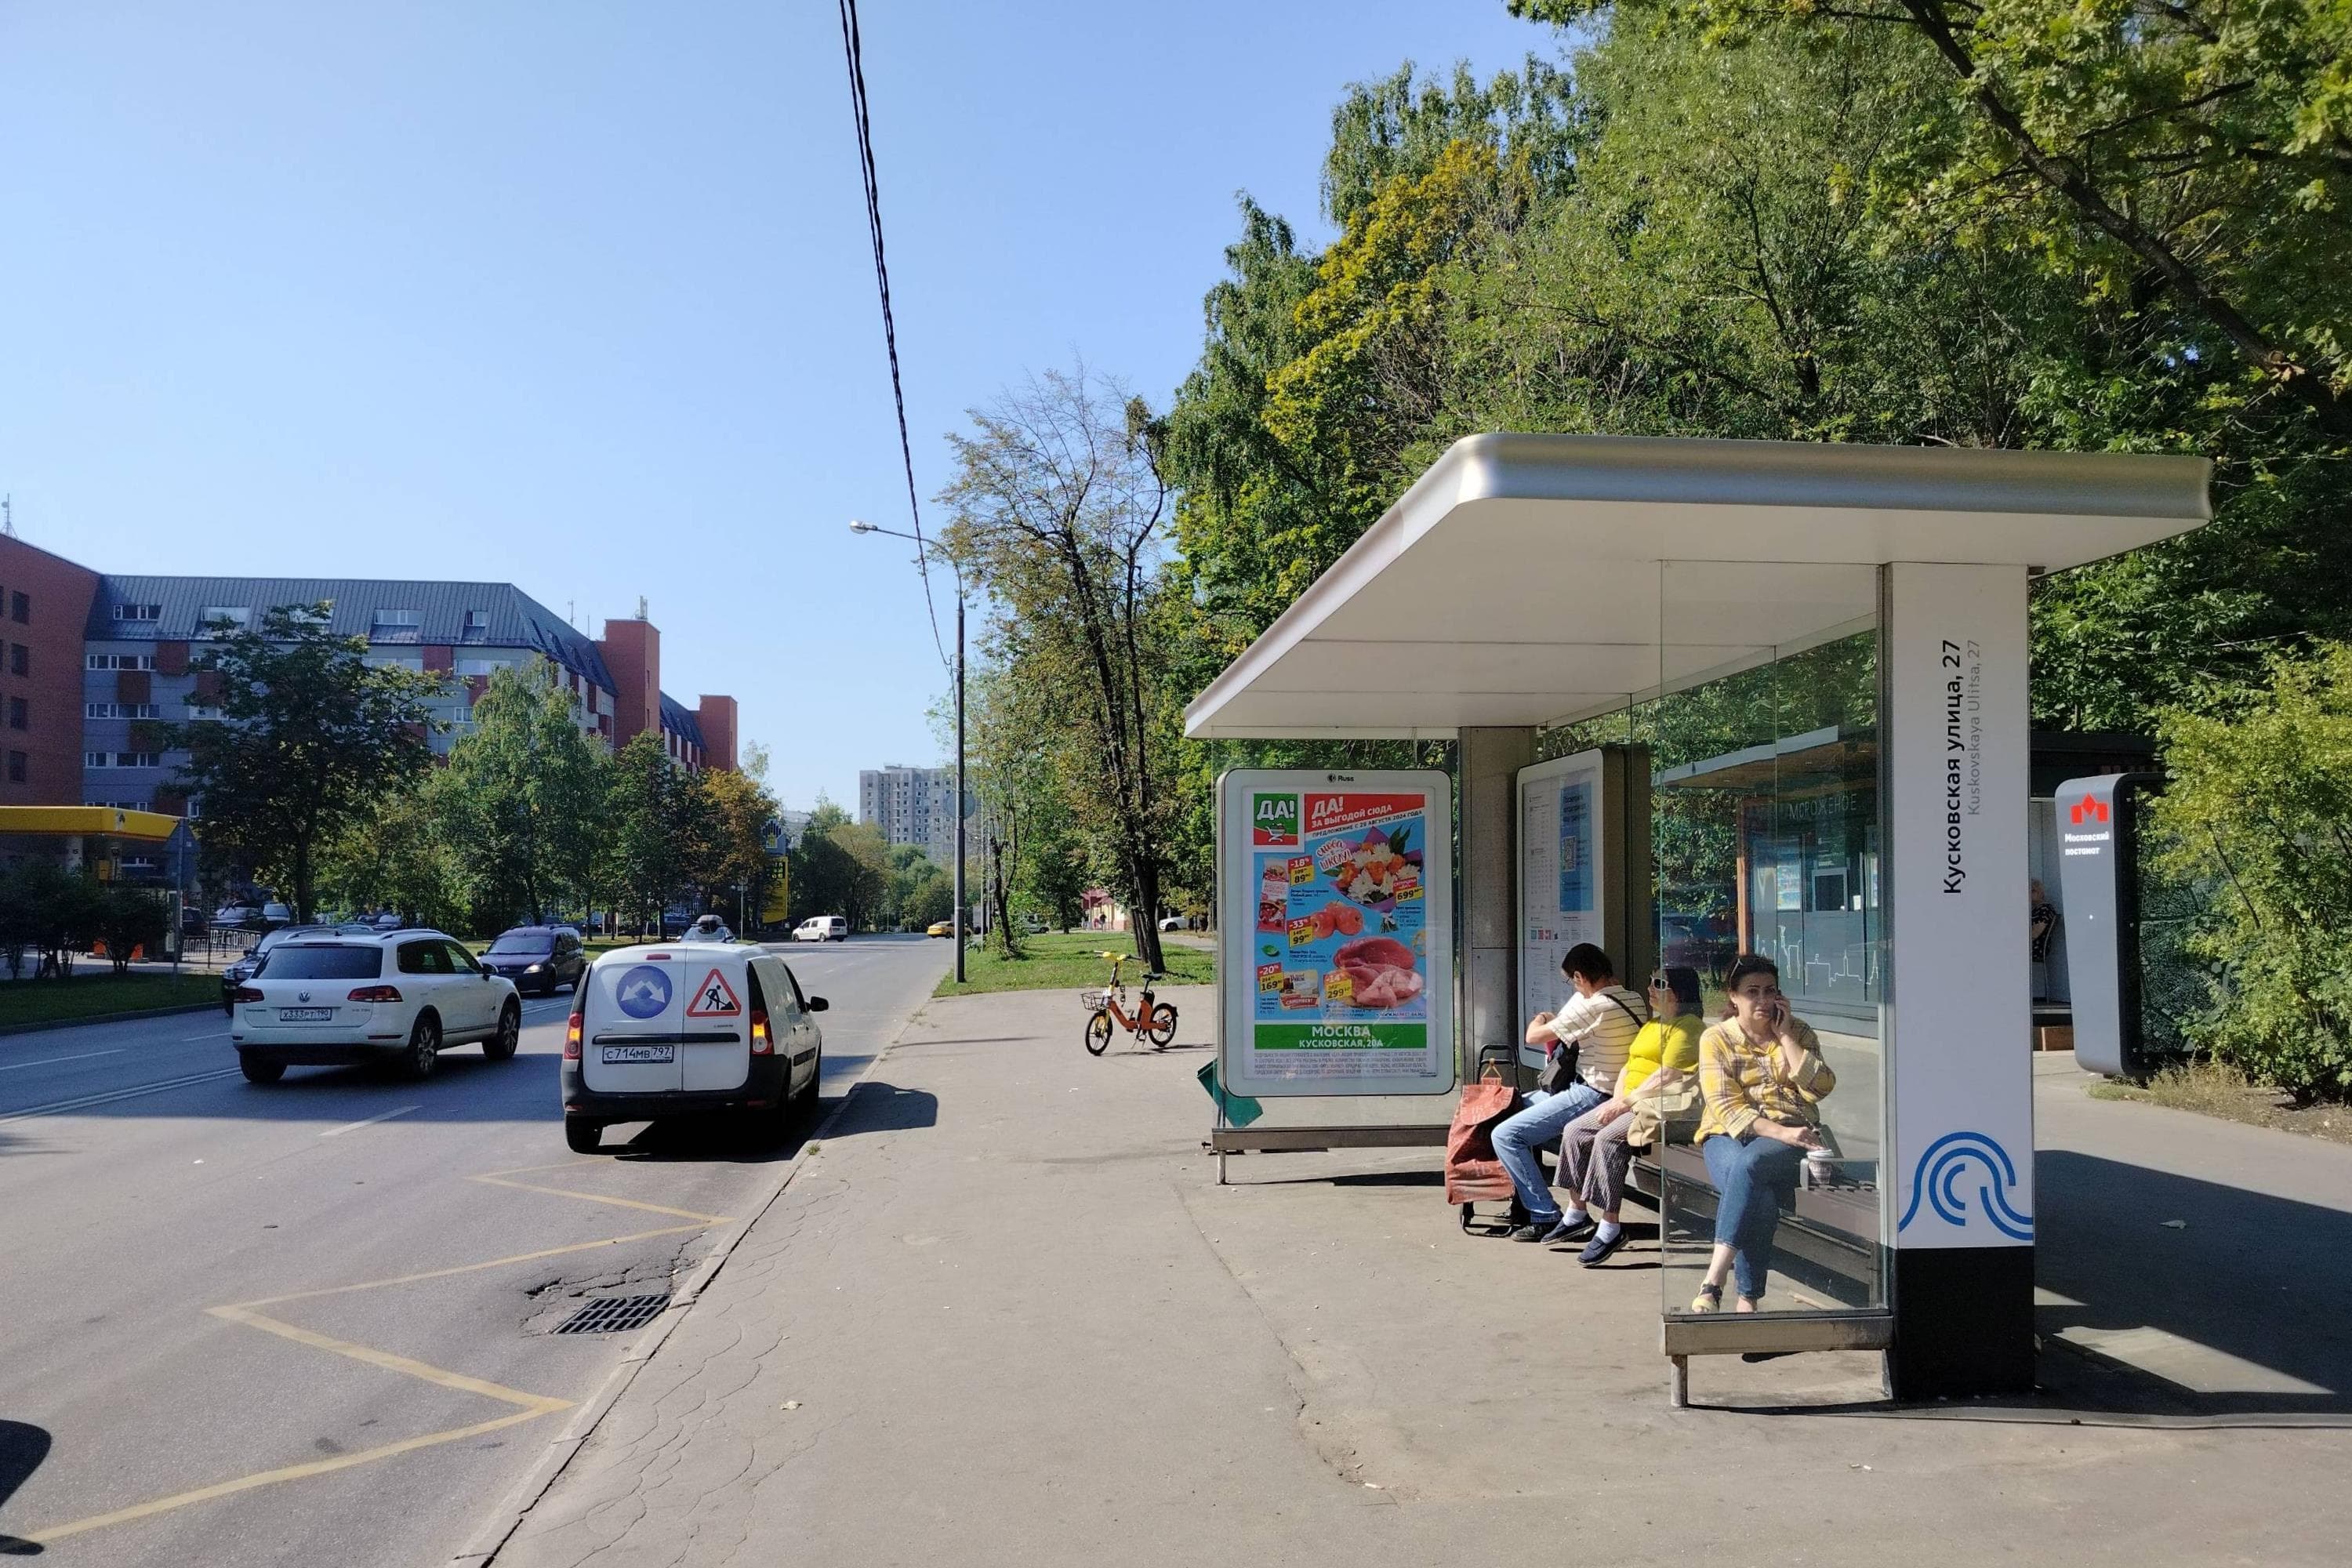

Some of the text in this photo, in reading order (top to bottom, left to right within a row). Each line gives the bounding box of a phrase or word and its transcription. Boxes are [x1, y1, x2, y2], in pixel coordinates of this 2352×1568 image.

[1967, 639, 1983, 815] Kuskovskaya Ulitsa, 27
[1942, 639, 1965, 895] Кусковская улица, 27
[1257, 800, 1295, 820] ДА!
[1311, 796, 1344, 818] ДА!
[1311, 804, 1392, 828] ЗА ВЫГОДОЙ СЮДА
[1788, 793, 1857, 822] МОРОЖЕНОЕ
[1312, 826, 1354, 838] ПРЕДЛОЖЕНИЕ
[1368, 817, 1392, 826] АВГУСТА
[1407, 810, 1422, 819] ГОДА
[2064, 831, 2109, 842] Московский
[2064, 847, 2101, 855] постамат
[1312, 1025, 1370, 1037] МОСКВА
[1298, 1039, 1384, 1048] КУСКОВСКАЯ, 20А
